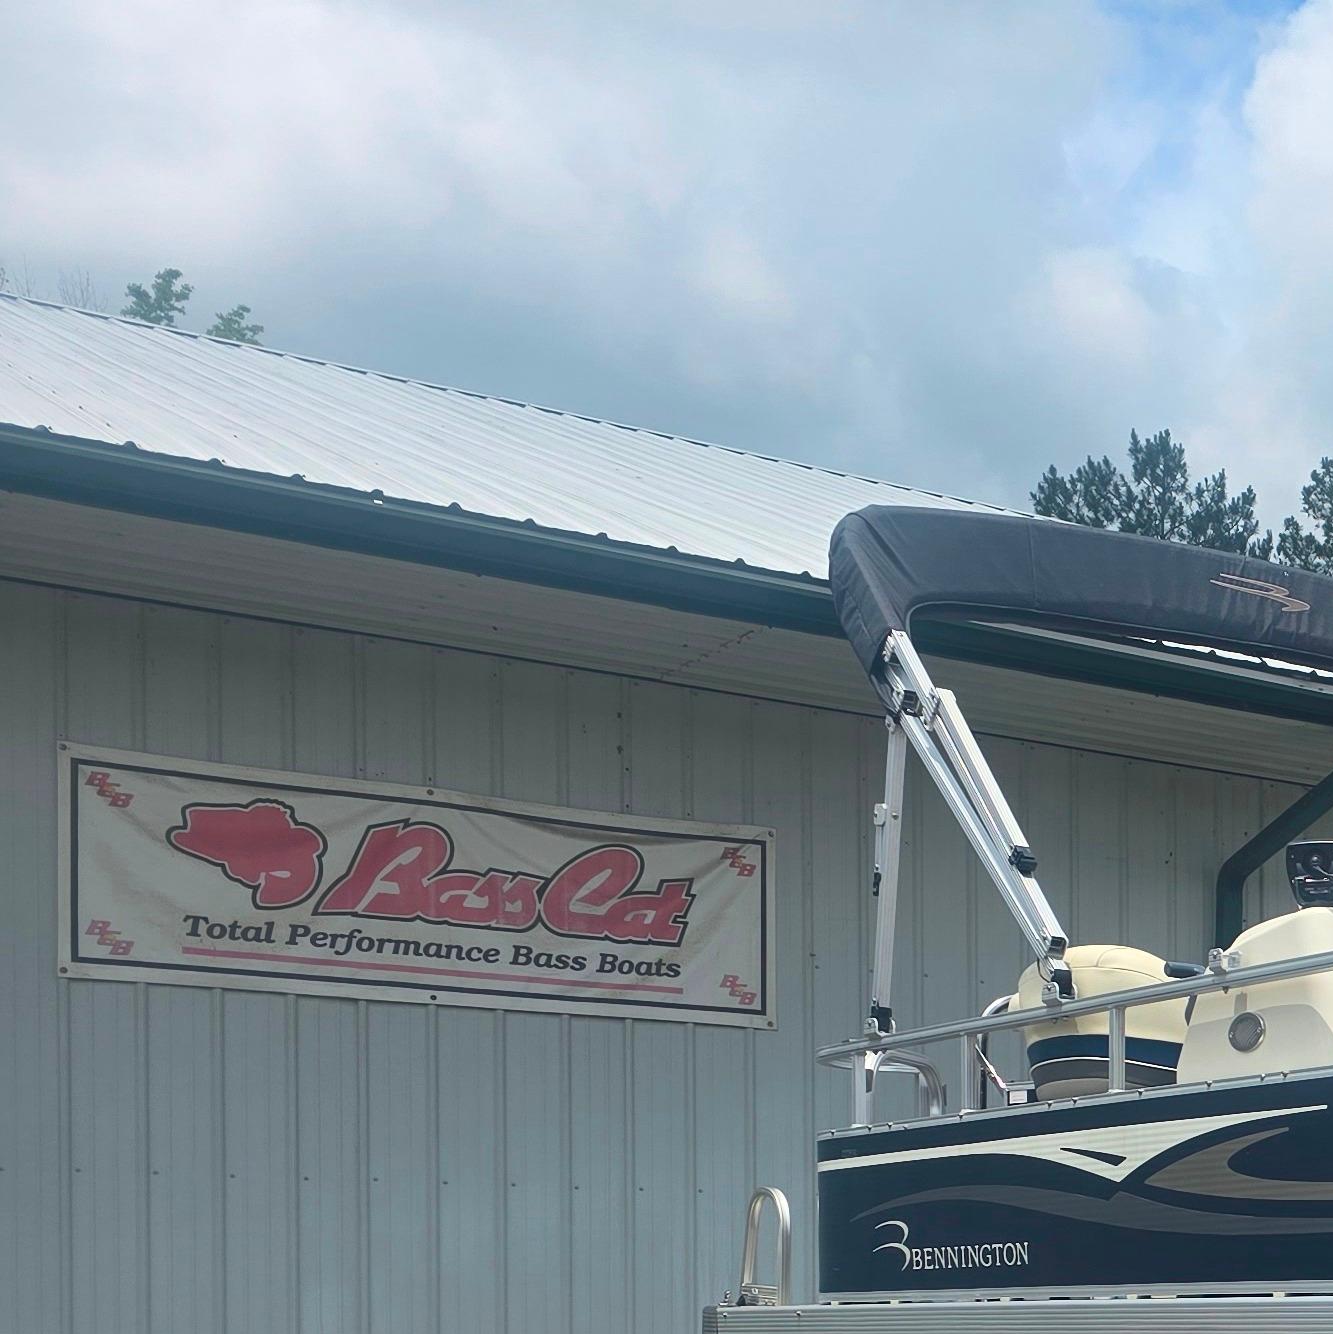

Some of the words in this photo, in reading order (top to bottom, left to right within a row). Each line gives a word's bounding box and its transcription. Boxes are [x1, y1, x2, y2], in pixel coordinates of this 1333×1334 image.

[311, 818, 542, 933] Bass
[541, 844, 697, 947] Cat
[183, 915, 275, 944] Total
[286, 923, 500, 963] Performance
[509, 945, 587, 972] Bass
[596, 953, 681, 978] Boats
[911, 1241, 1029, 1270] BENNINGTON
